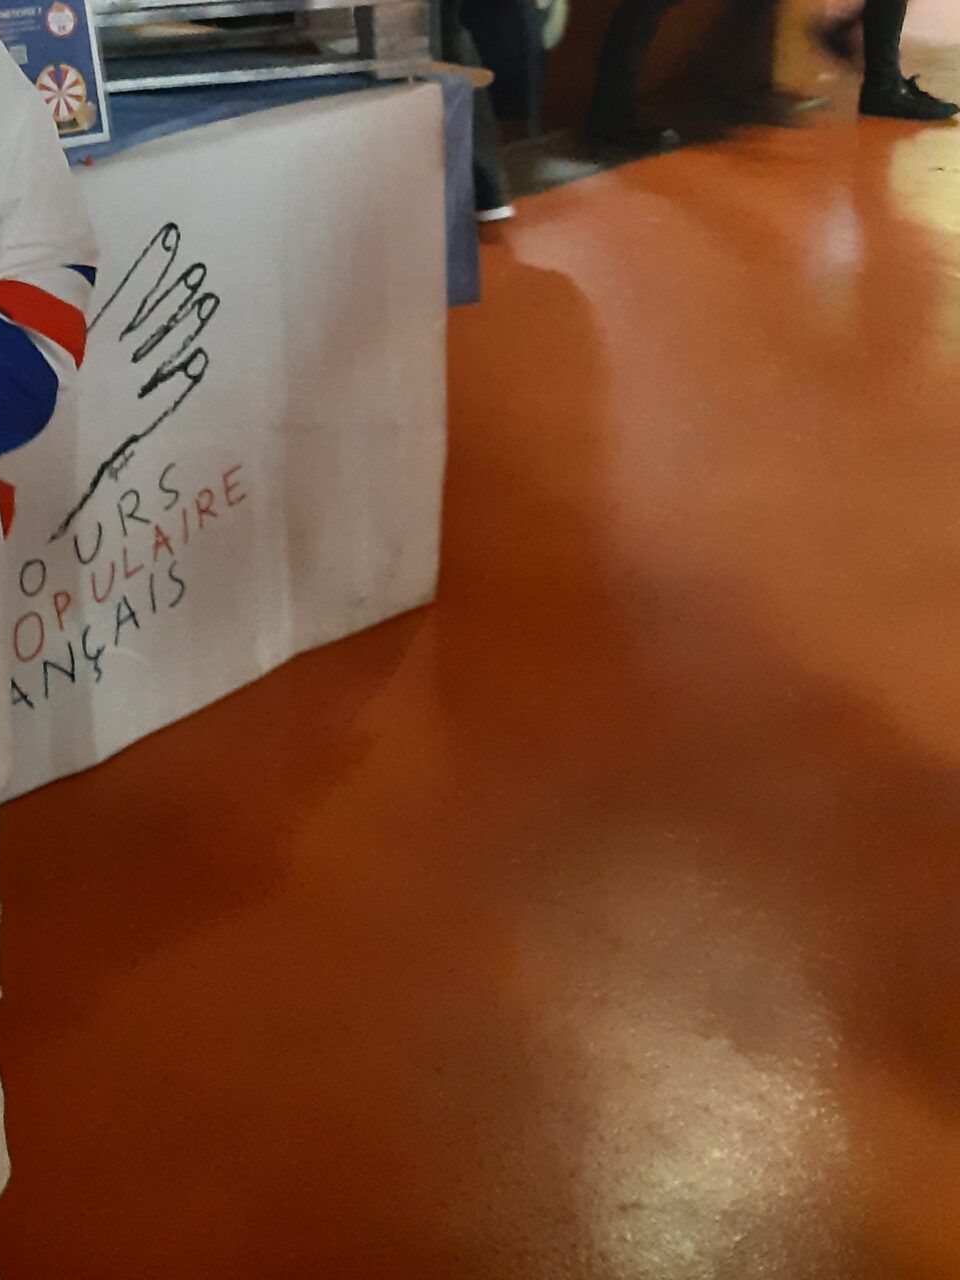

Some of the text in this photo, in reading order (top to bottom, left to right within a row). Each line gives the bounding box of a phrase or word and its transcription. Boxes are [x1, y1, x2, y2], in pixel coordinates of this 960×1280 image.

[14, 465, 246, 663] OPULAIRE
[19, 462, 180, 597] OURS
[10, 559, 185, 710] ANÇAIS
